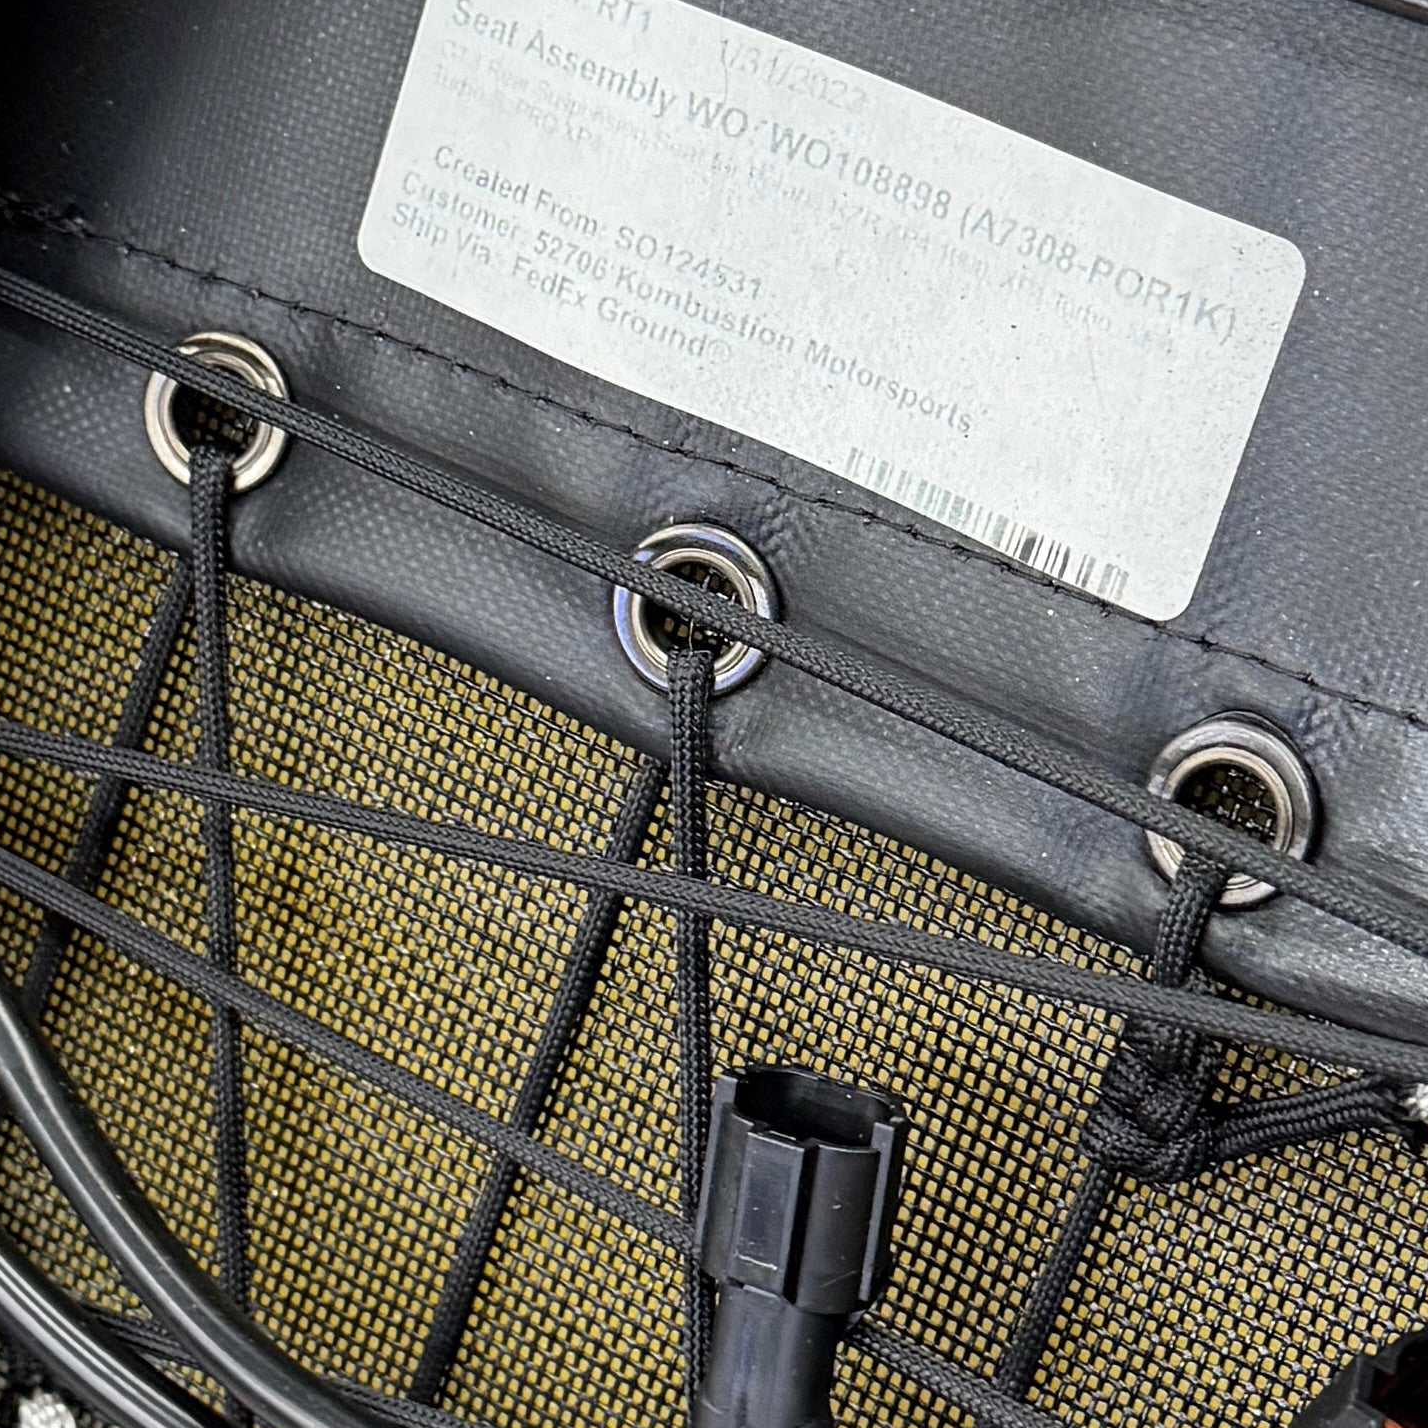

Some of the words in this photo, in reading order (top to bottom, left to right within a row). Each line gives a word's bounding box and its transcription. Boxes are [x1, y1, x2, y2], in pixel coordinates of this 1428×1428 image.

[522, 30, 677, 120] Assembly
[767, 124, 952, 222] WO108898
[391, 203, 448, 247] Ship
[511, 256, 589, 308] FedEx
[433, 145, 530, 204] Created
[615, 225, 760, 302] SO124531
[616, 265, 795, 357] Kombustion
[802, 340, 975, 434] Motorsports
